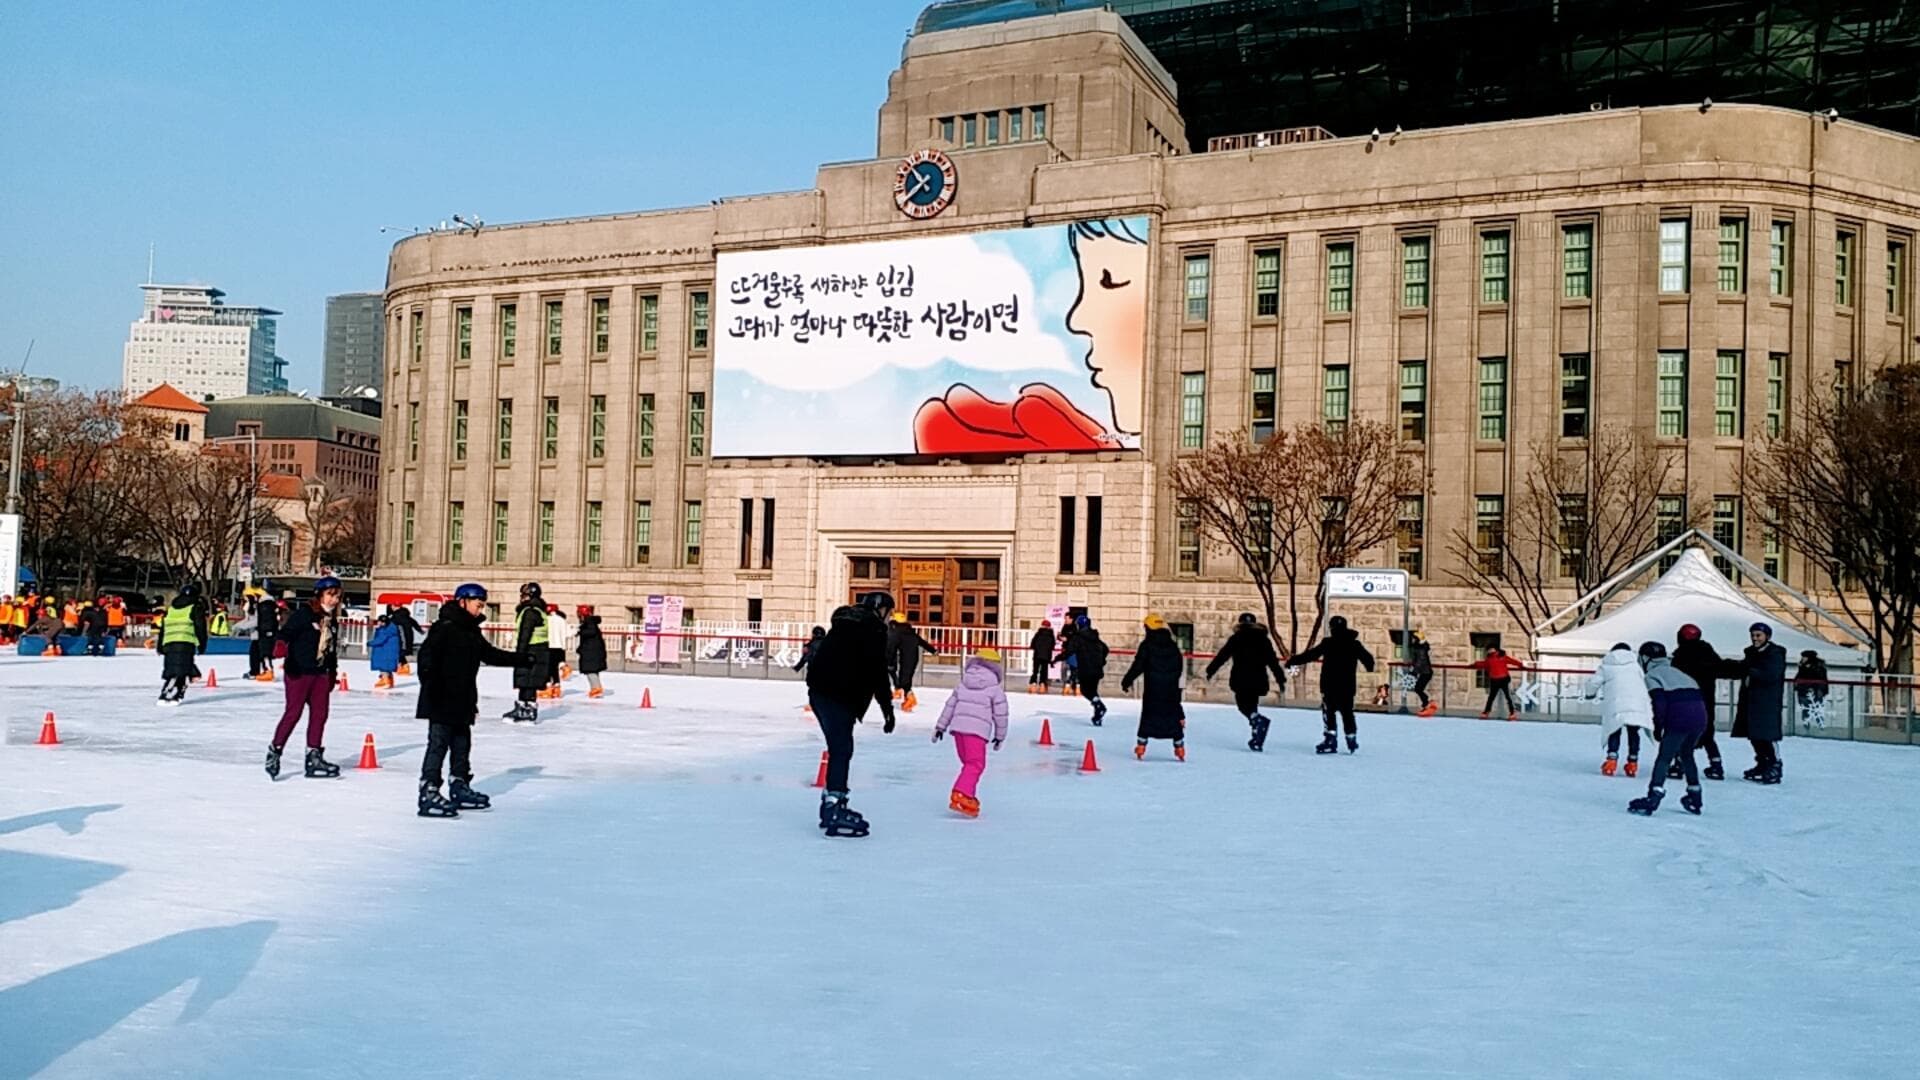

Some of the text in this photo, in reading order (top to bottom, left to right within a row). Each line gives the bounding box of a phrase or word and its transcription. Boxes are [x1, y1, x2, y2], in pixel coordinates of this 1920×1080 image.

[731, 264, 914, 309] 뜨거울수록 새하얀 입김
[728, 293, 1019, 344] 그대가 얼마나 따뜻한 사람이면
[1375, 583, 1397, 592] GATE
